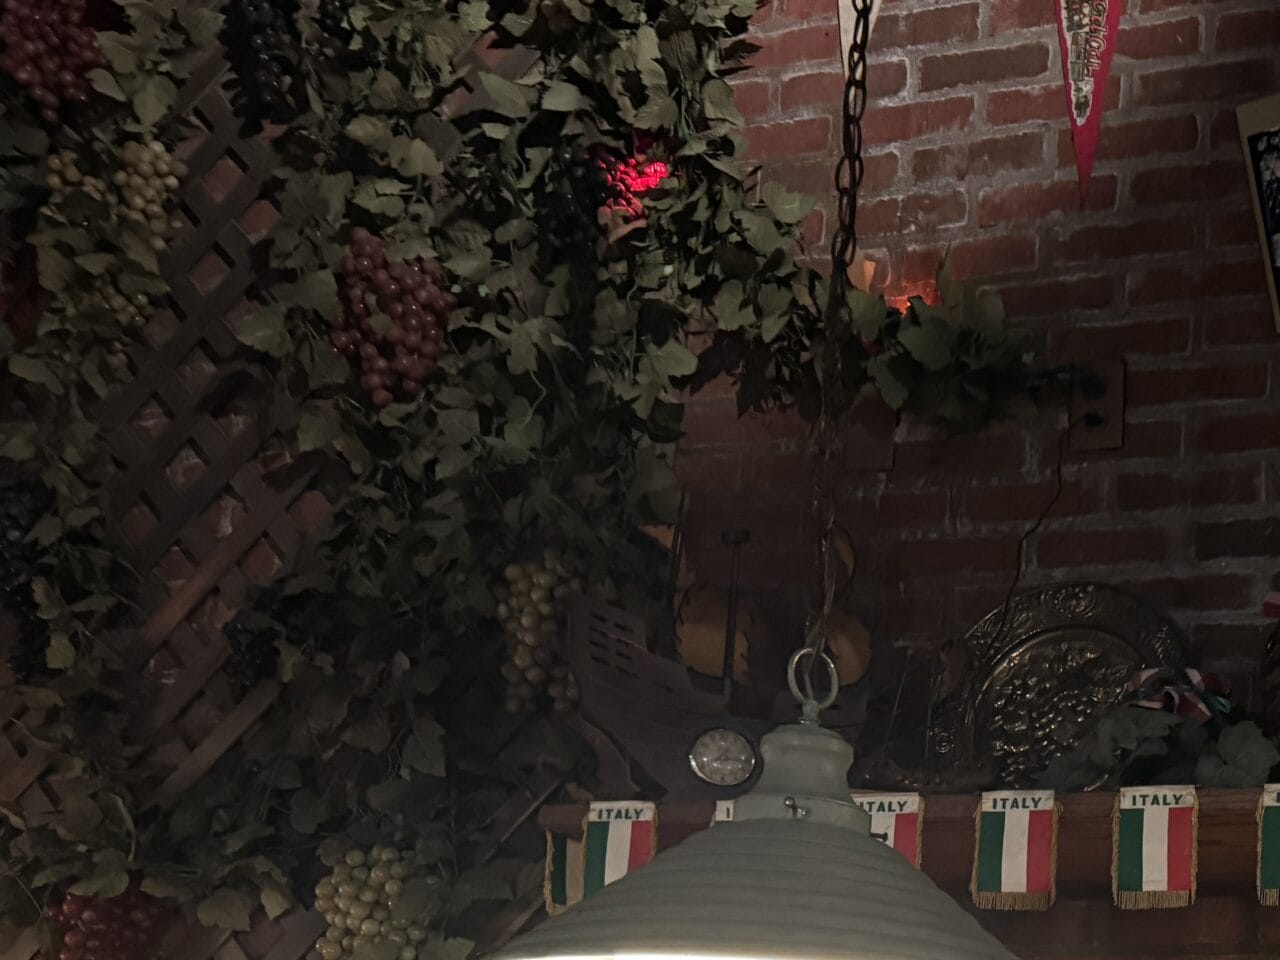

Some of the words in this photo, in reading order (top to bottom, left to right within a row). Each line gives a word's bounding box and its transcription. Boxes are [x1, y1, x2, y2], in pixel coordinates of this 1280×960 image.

[992, 797, 1042, 810] ITALY
[1132, 794, 1184, 806] ITALY
[598, 808, 645, 820] ITALY
